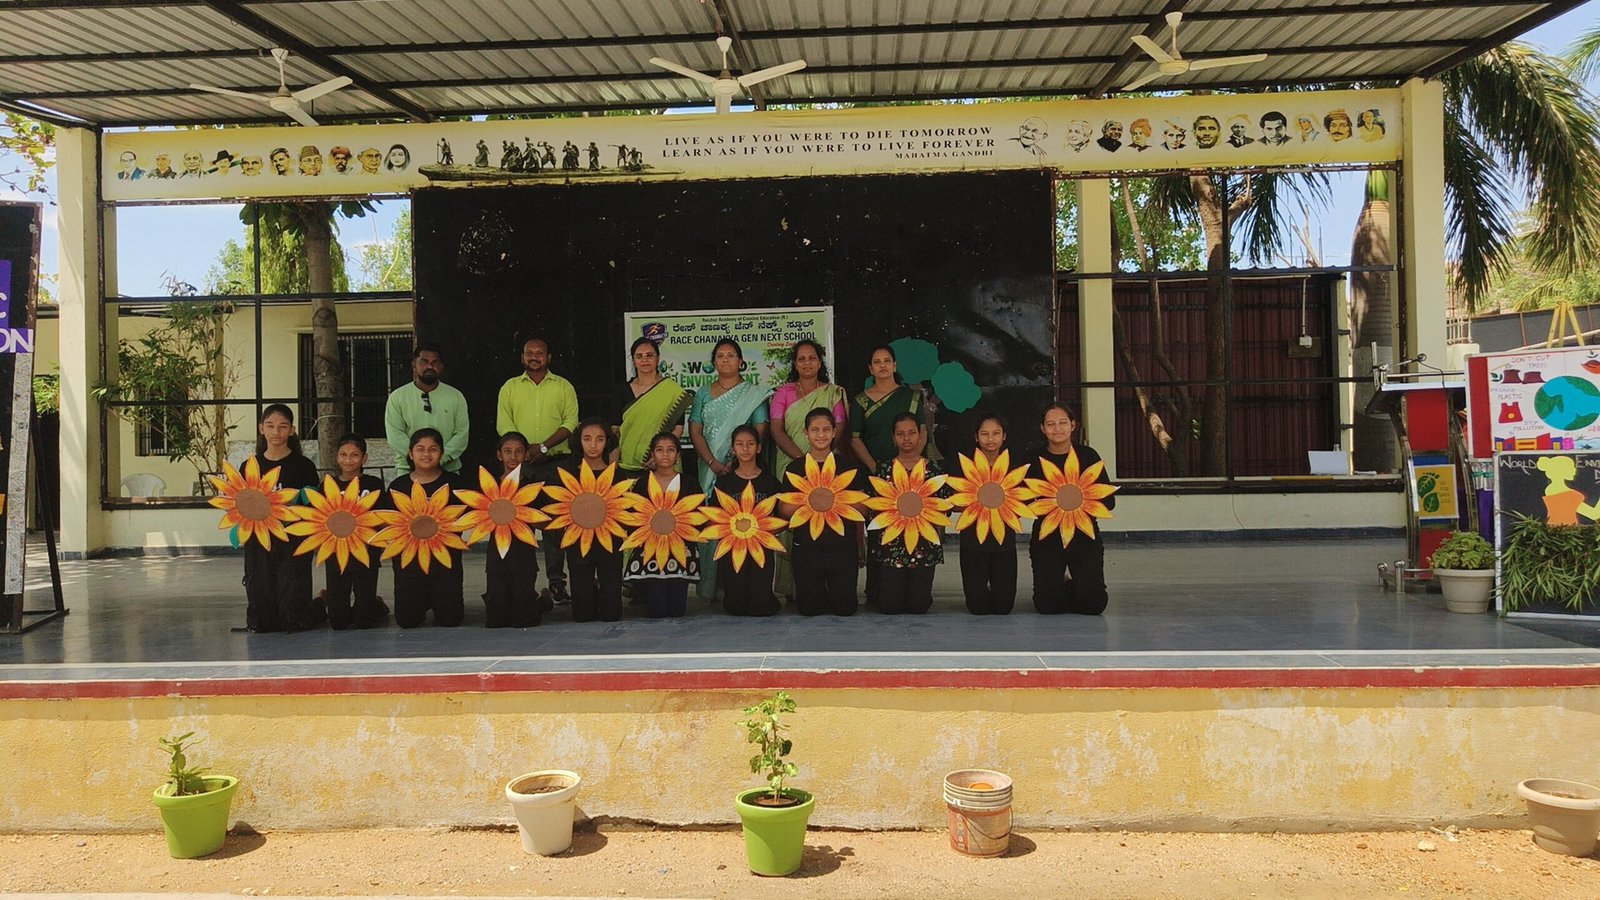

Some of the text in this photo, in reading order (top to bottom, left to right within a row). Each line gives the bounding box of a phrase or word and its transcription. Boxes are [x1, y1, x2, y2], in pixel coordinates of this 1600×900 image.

[665, 127, 992, 146] LIVE AS IF YOU WERE TO DIE TOMORROW
[662, 139, 995, 157] LEARN AS IF YOU WERE TO LIVE FOREVER
[670, 336, 692, 344] RACE
[741, 333, 758, 342] GEN
[760, 333, 782, 341] NEXT
[784, 332, 817, 341] SCHOOL
